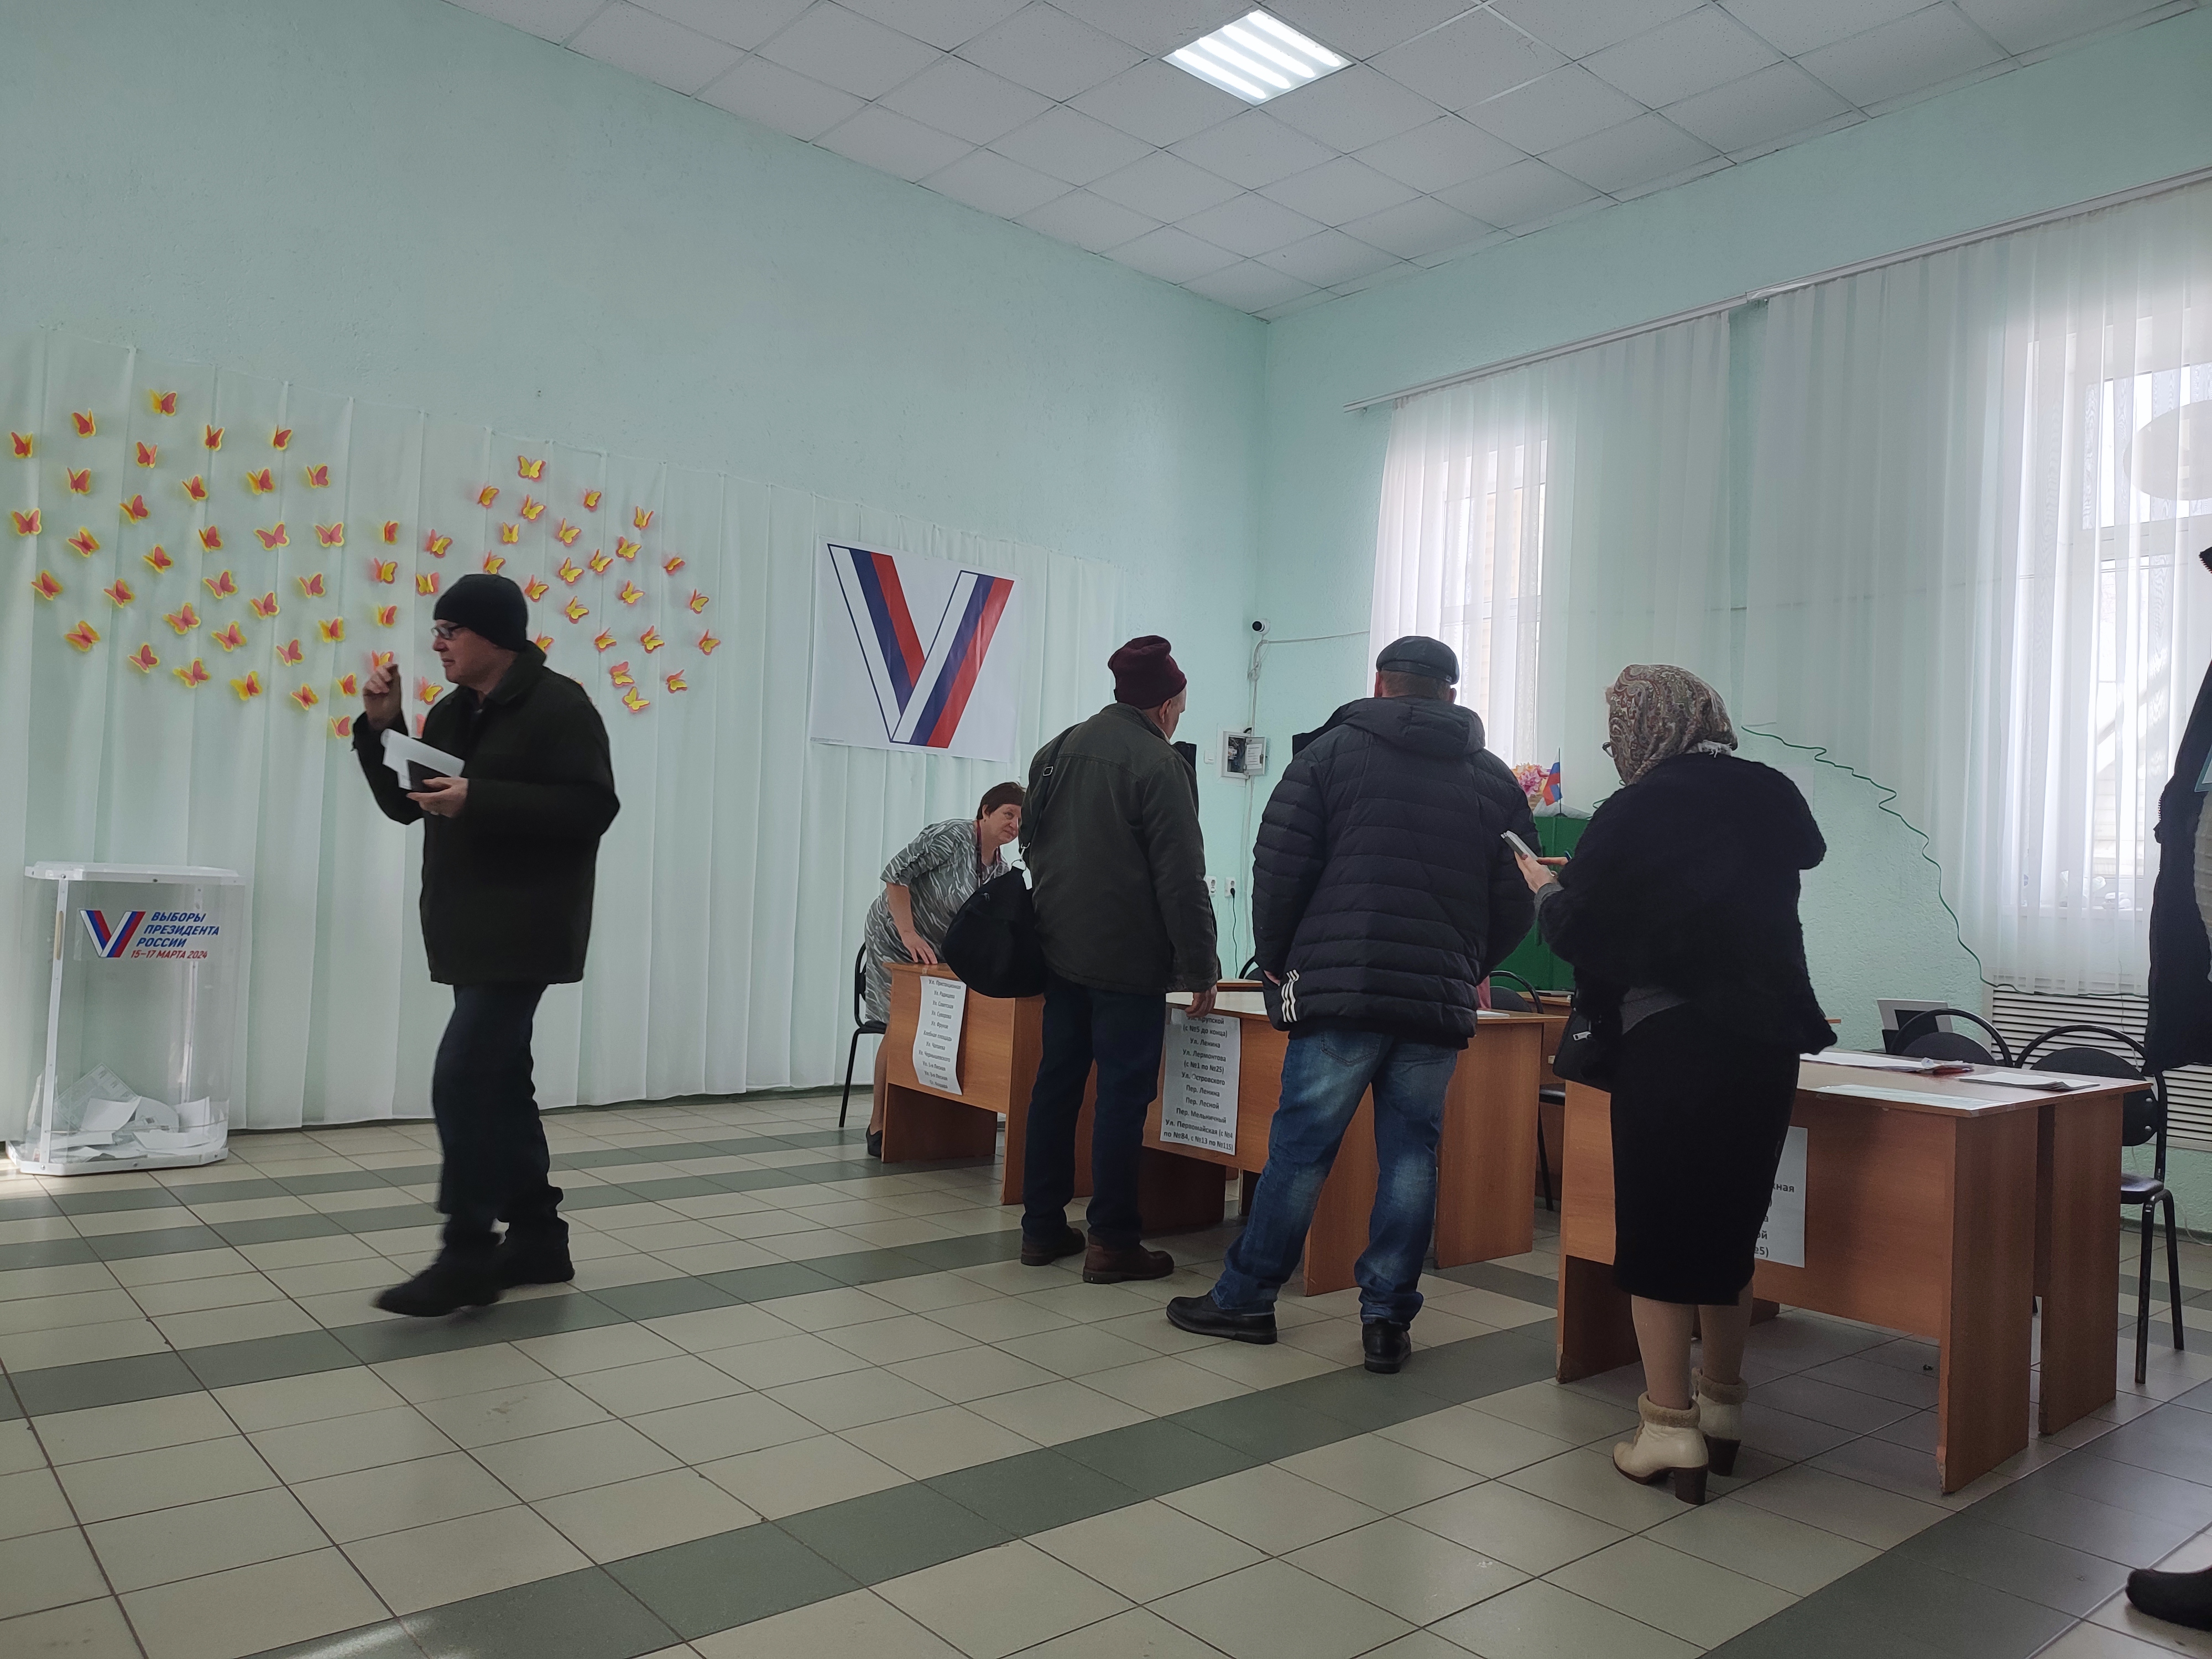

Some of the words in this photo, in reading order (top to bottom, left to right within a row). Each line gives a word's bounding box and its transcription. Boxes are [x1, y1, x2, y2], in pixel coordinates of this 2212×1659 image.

[151, 912, 206, 922] ВЫБОРЫ
[144, 925, 220, 936] ПРЕЗИДЕНТА
[136, 937, 187, 947] РОССИИ
[156, 950, 186, 958] МАРТА
[187, 950, 207, 958] 2024
[1209, 1030, 1227, 1038] конца)
[1200, 1039, 1220, 1048] Ленина
[1193, 1050, 1226, 1062] Лермонтова
[1184, 1060, 1189, 1068] (с
[1209, 1065, 1224, 1074] №25)
[1192, 1073, 1225, 1085] Островского
[1186, 1084, 1198, 1093] Пер.
[1199, 1087, 1220, 1097] Ленина
[1186, 1097, 1198, 1105] Пер.
[1199, 1100, 1219, 1109] Лесной
[1176, 1108, 1190, 1117] Пер.
[1191, 1110, 1226, 1123] Мельничный
[1177, 1120, 1217, 1135] Первомайская
[1173, 1131, 1190, 1141] №84,
[1195, 1136, 1207, 1144] №13
[1217, 1140, 1233, 1151] №115)
